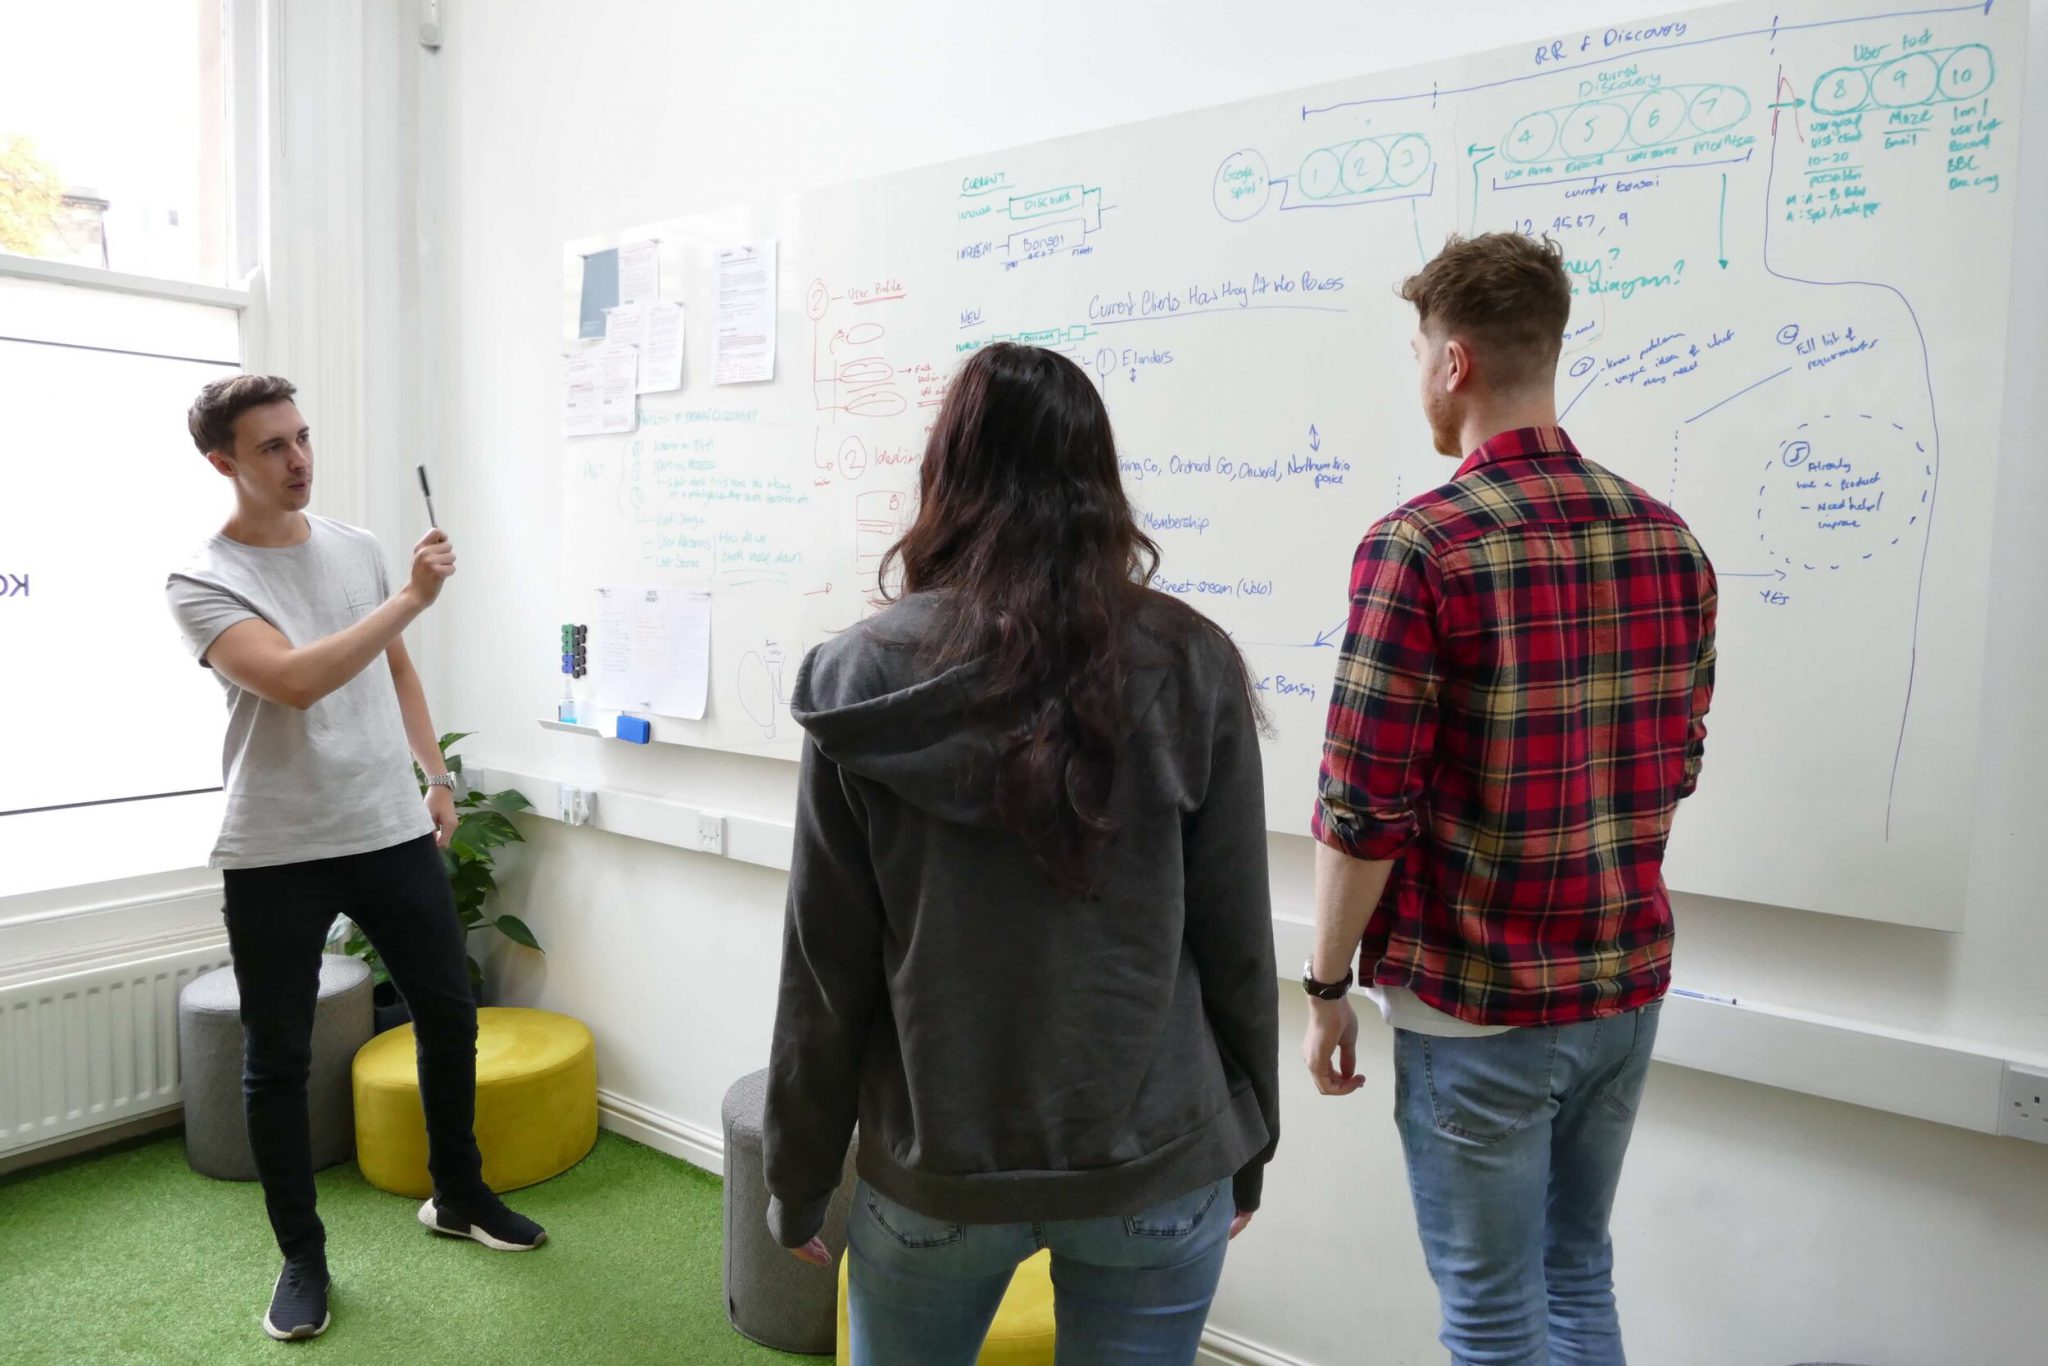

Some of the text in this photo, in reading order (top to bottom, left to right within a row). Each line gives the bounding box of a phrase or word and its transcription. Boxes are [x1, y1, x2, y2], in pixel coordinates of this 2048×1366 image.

[1604, 22, 1687, 47] Discovery
[1579, 73, 1661, 98] Discovery
[1947, 154, 1980, 173] BBC
[1143, 512, 1210, 535] Membership
